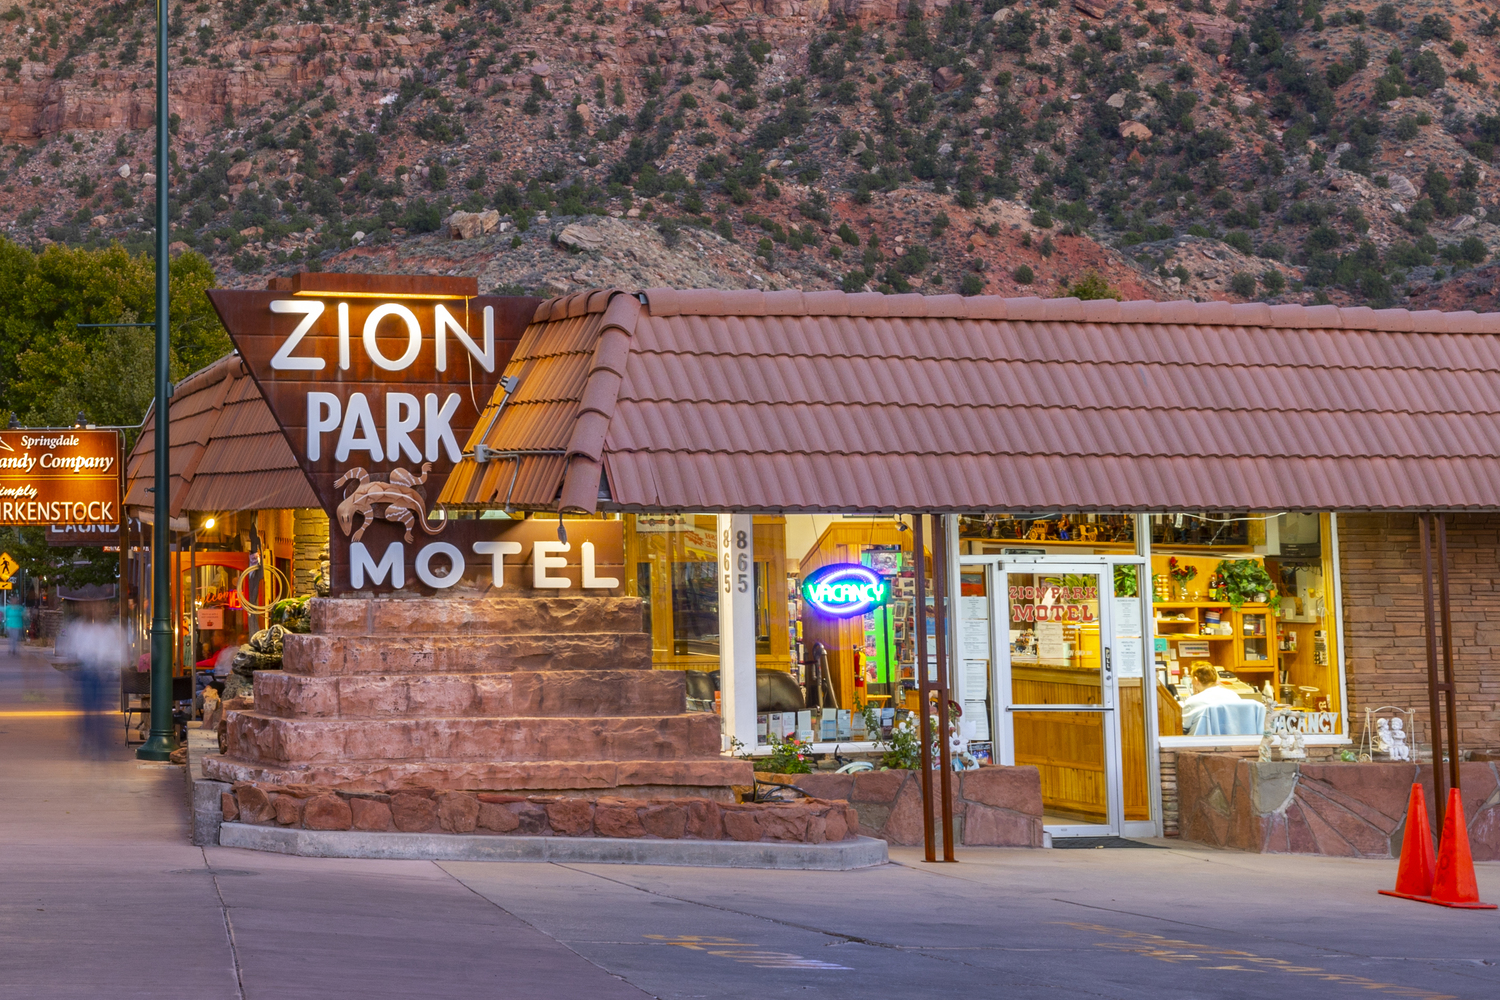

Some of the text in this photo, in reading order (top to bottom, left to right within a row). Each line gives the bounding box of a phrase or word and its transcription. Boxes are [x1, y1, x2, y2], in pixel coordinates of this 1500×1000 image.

[269, 299, 495, 374] ZION
[306, 391, 462, 464] PARK
[20, 434, 80, 449] Springdale
[39, 452, 114, 473] Company
[348, 540, 619, 590] MOTEL
[808, 583, 884, 603] VACANCY
[1008, 585, 1098, 600] ZION PARK
[1012, 603, 1095, 623] MOTEL
